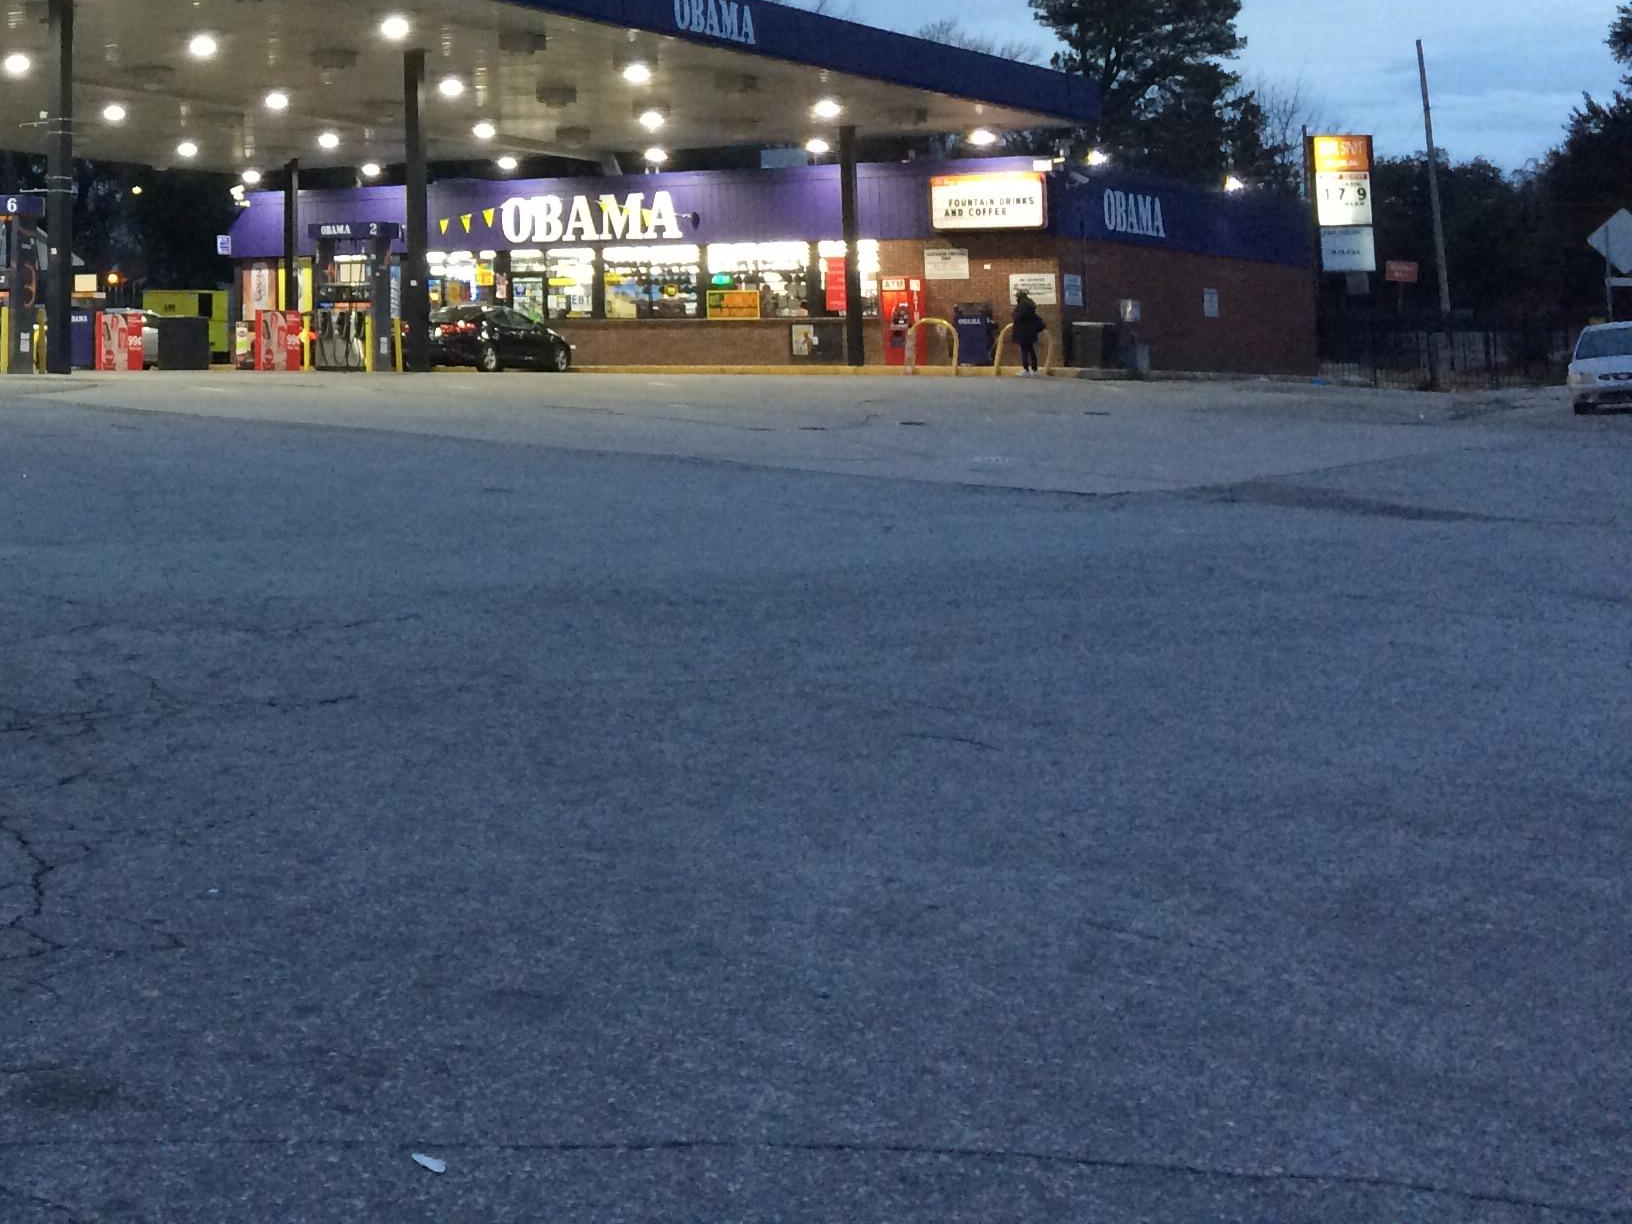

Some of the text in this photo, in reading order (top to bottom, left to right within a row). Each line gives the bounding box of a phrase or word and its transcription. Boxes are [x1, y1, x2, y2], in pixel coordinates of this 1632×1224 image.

[6, 198, 17, 213] 6
[948, 196, 1035, 208] FOUNTAIN DRINKS
[500, 190, 683, 244] OBAMA
[944, 207, 1008, 217] AND COFFEE
[1103, 188, 1167, 238] OBAMA
[320, 222, 378, 236] OBAMA 2
